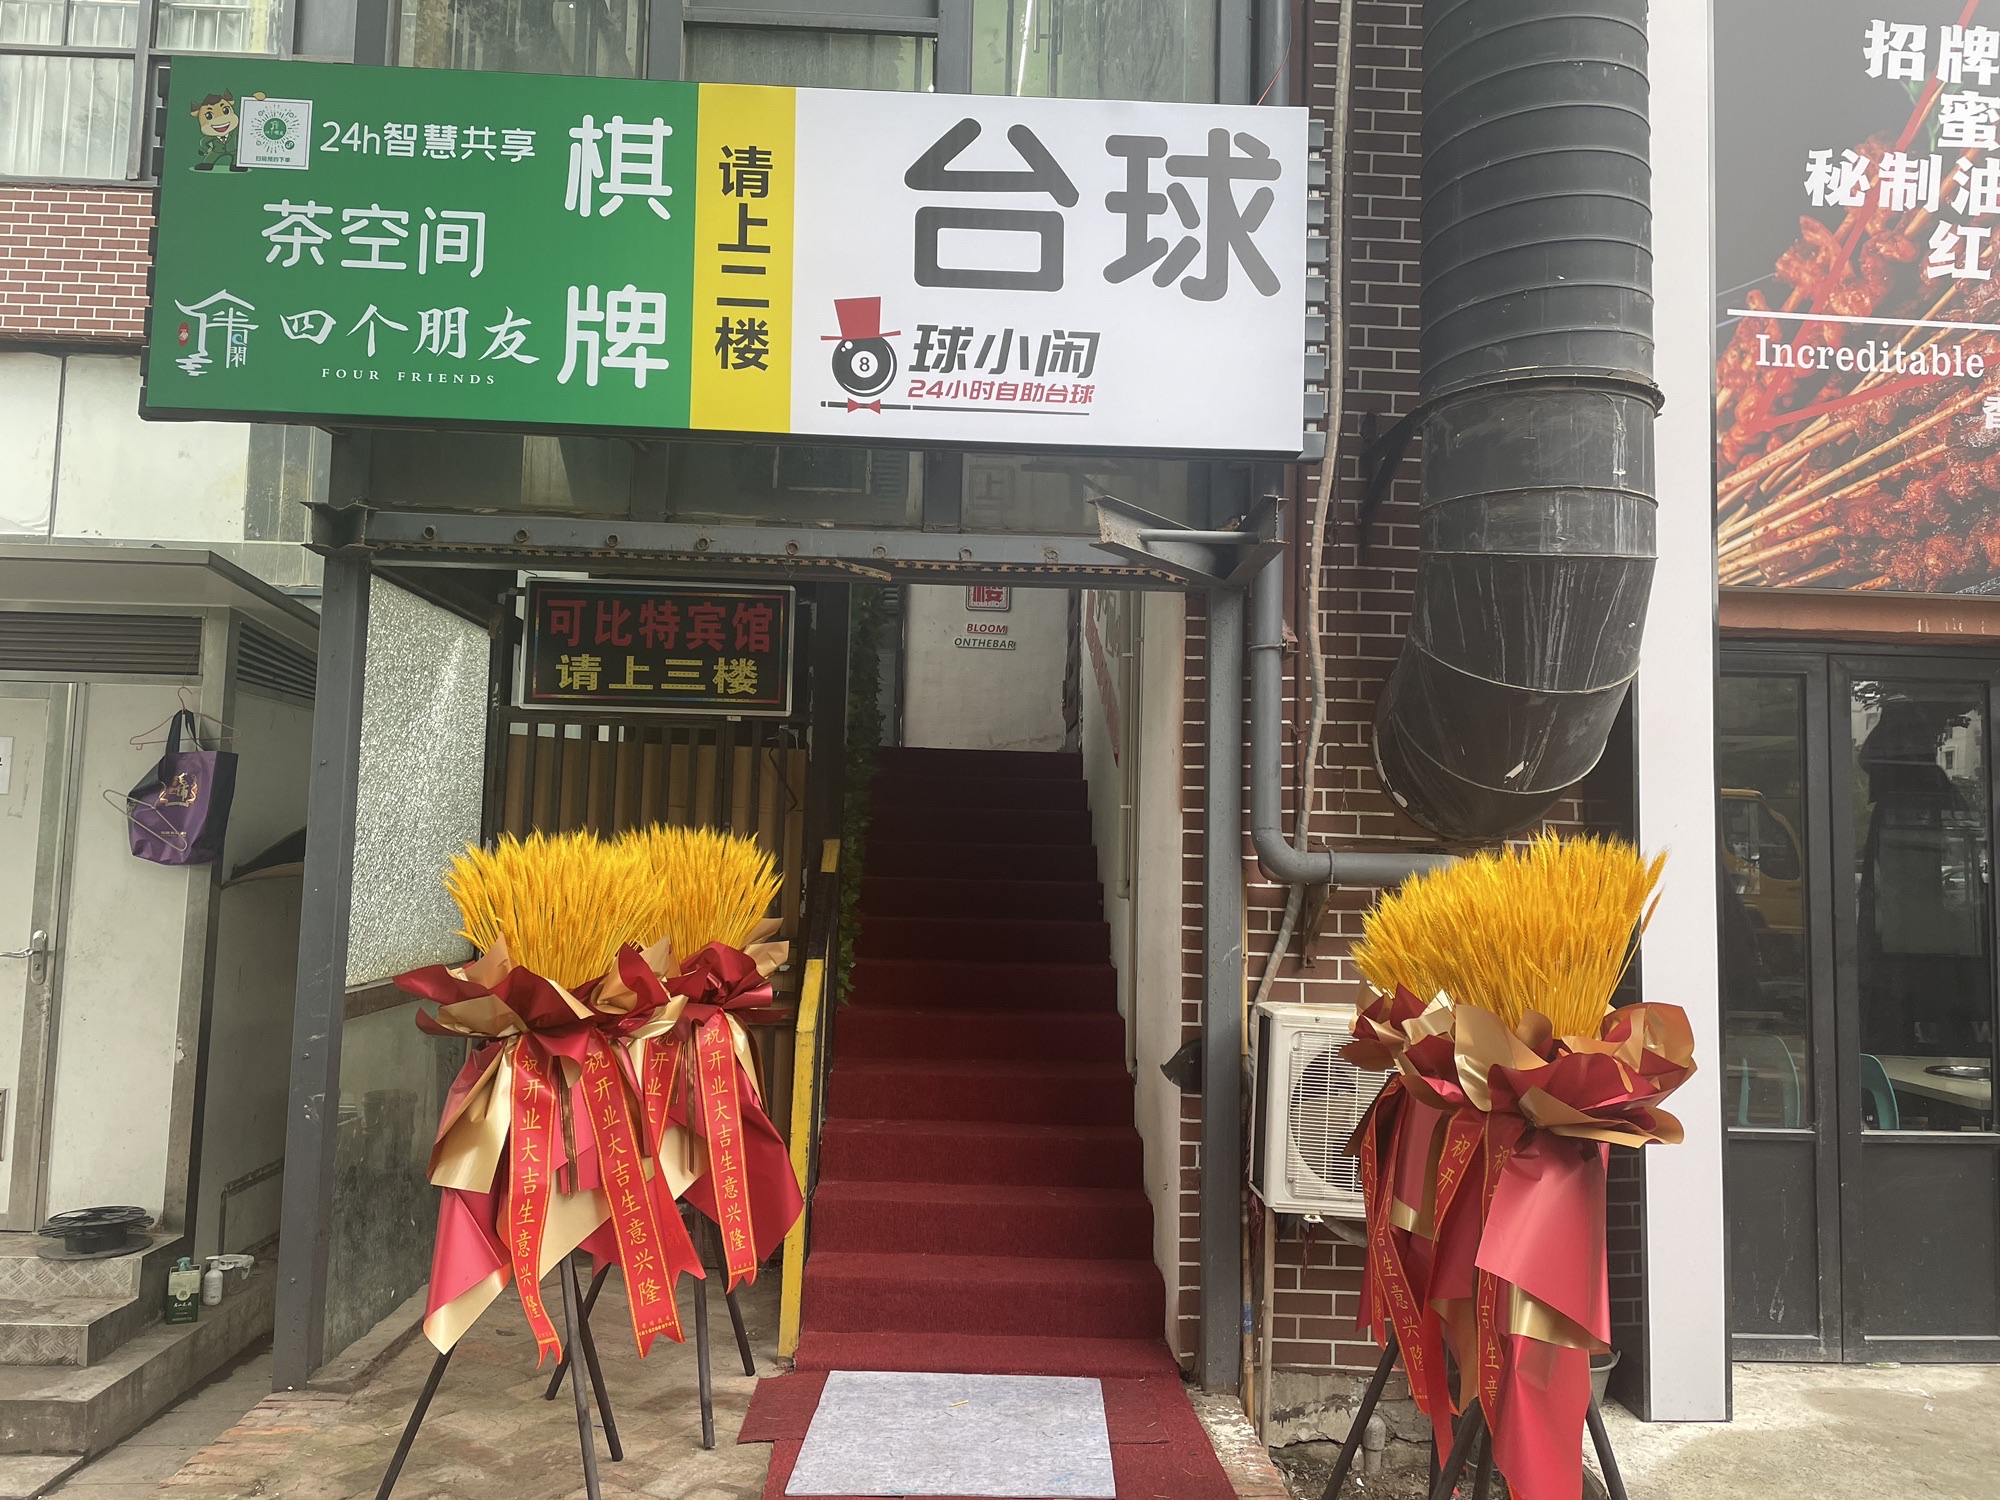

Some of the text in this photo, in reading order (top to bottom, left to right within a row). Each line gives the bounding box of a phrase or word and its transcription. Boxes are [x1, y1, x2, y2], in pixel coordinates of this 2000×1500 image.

[1863, 19, 2000, 85] 招牌
[320, 121, 537, 163] 24h智慧共享
[1937, 90, 2000, 152] 蜜
[903, 117, 1282, 302] 台球
[1803, 148, 2000, 216] 秘制油
[261, 199, 486, 278] 茶空间
[556, 114, 674, 389] 棋牌
[714, 145, 773, 372] 请上二楼
[279, 303, 540, 364] 四个朋友
[859, 356, 871, 372] 8
[908, 324, 1101, 379] 球小闹
[1755, 334, 1984, 379] Increditable
[321, 367, 495, 385] FOUR FRIENDS
[907, 379, 1096, 405] 24小时自助台球
[547, 599, 773, 653] 可比特宾馆
[954, 637, 1016, 650] ONTHEBAR
[966, 623, 1008, 634] BLOOM
[555, 653, 758, 695] 请上三楼
[703, 1027, 746, 1252] 祝开业大吉生意兴隆
[515, 1054, 546, 1319] 祝开业大吉生意兴隆
[585, 1050, 662, 1307] 祝开业大吉生意兴隆
